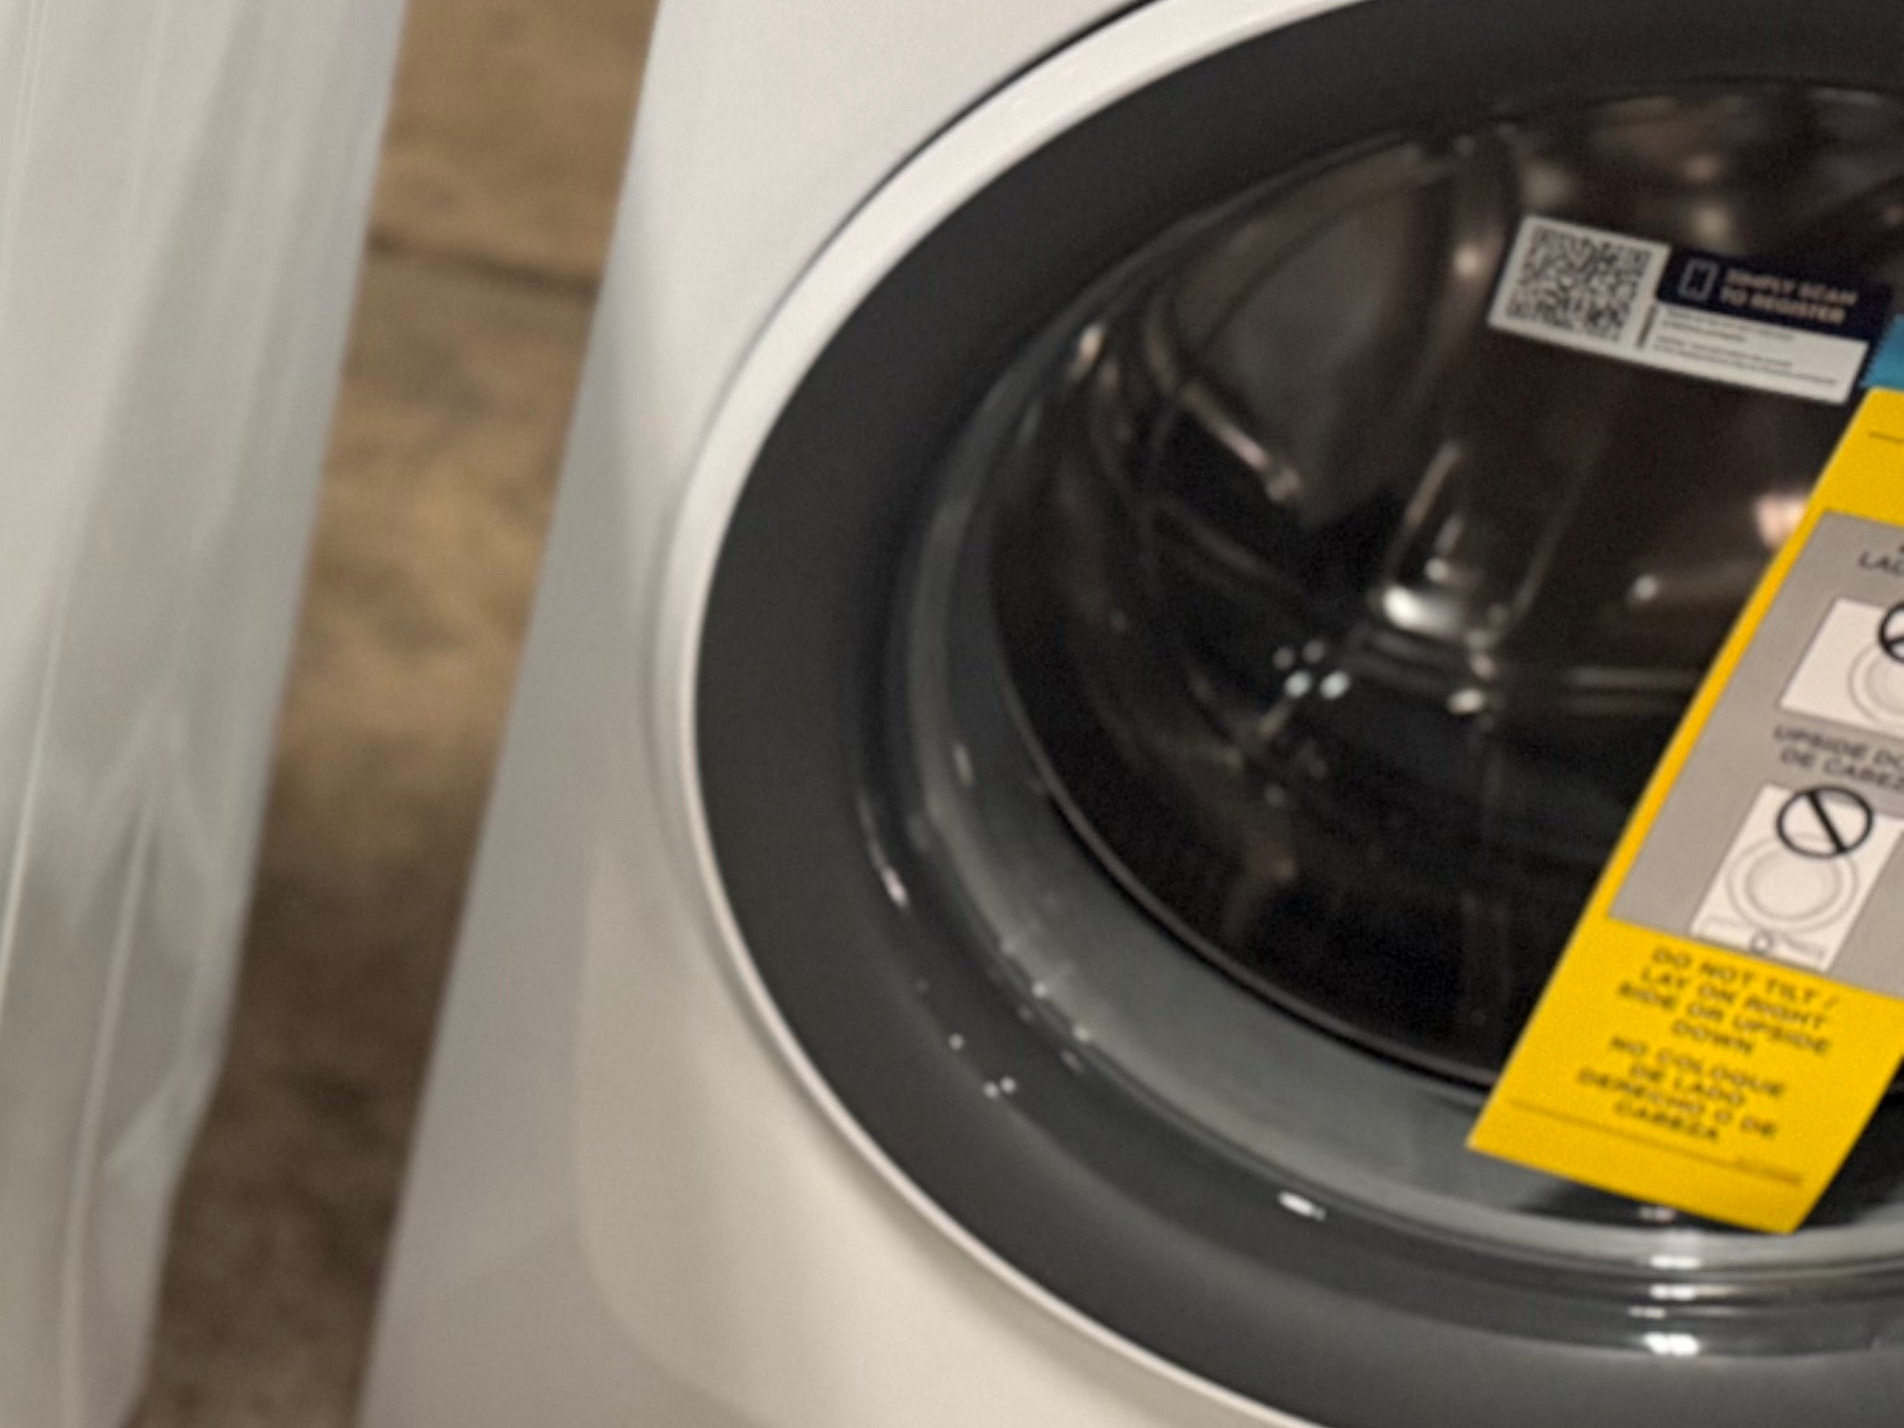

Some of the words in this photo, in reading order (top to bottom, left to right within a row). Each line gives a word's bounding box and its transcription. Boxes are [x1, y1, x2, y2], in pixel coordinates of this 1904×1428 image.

[1652, 947, 1692, 969] DO
[1700, 960, 1755, 986] NOT
[1618, 980, 1677, 1010] SIDE
[1732, 1016, 1831, 1054] UPSIDE
[1744, 995, 1827, 1029] RIGHT
[1671, 1018, 1755, 1055] DOWN
